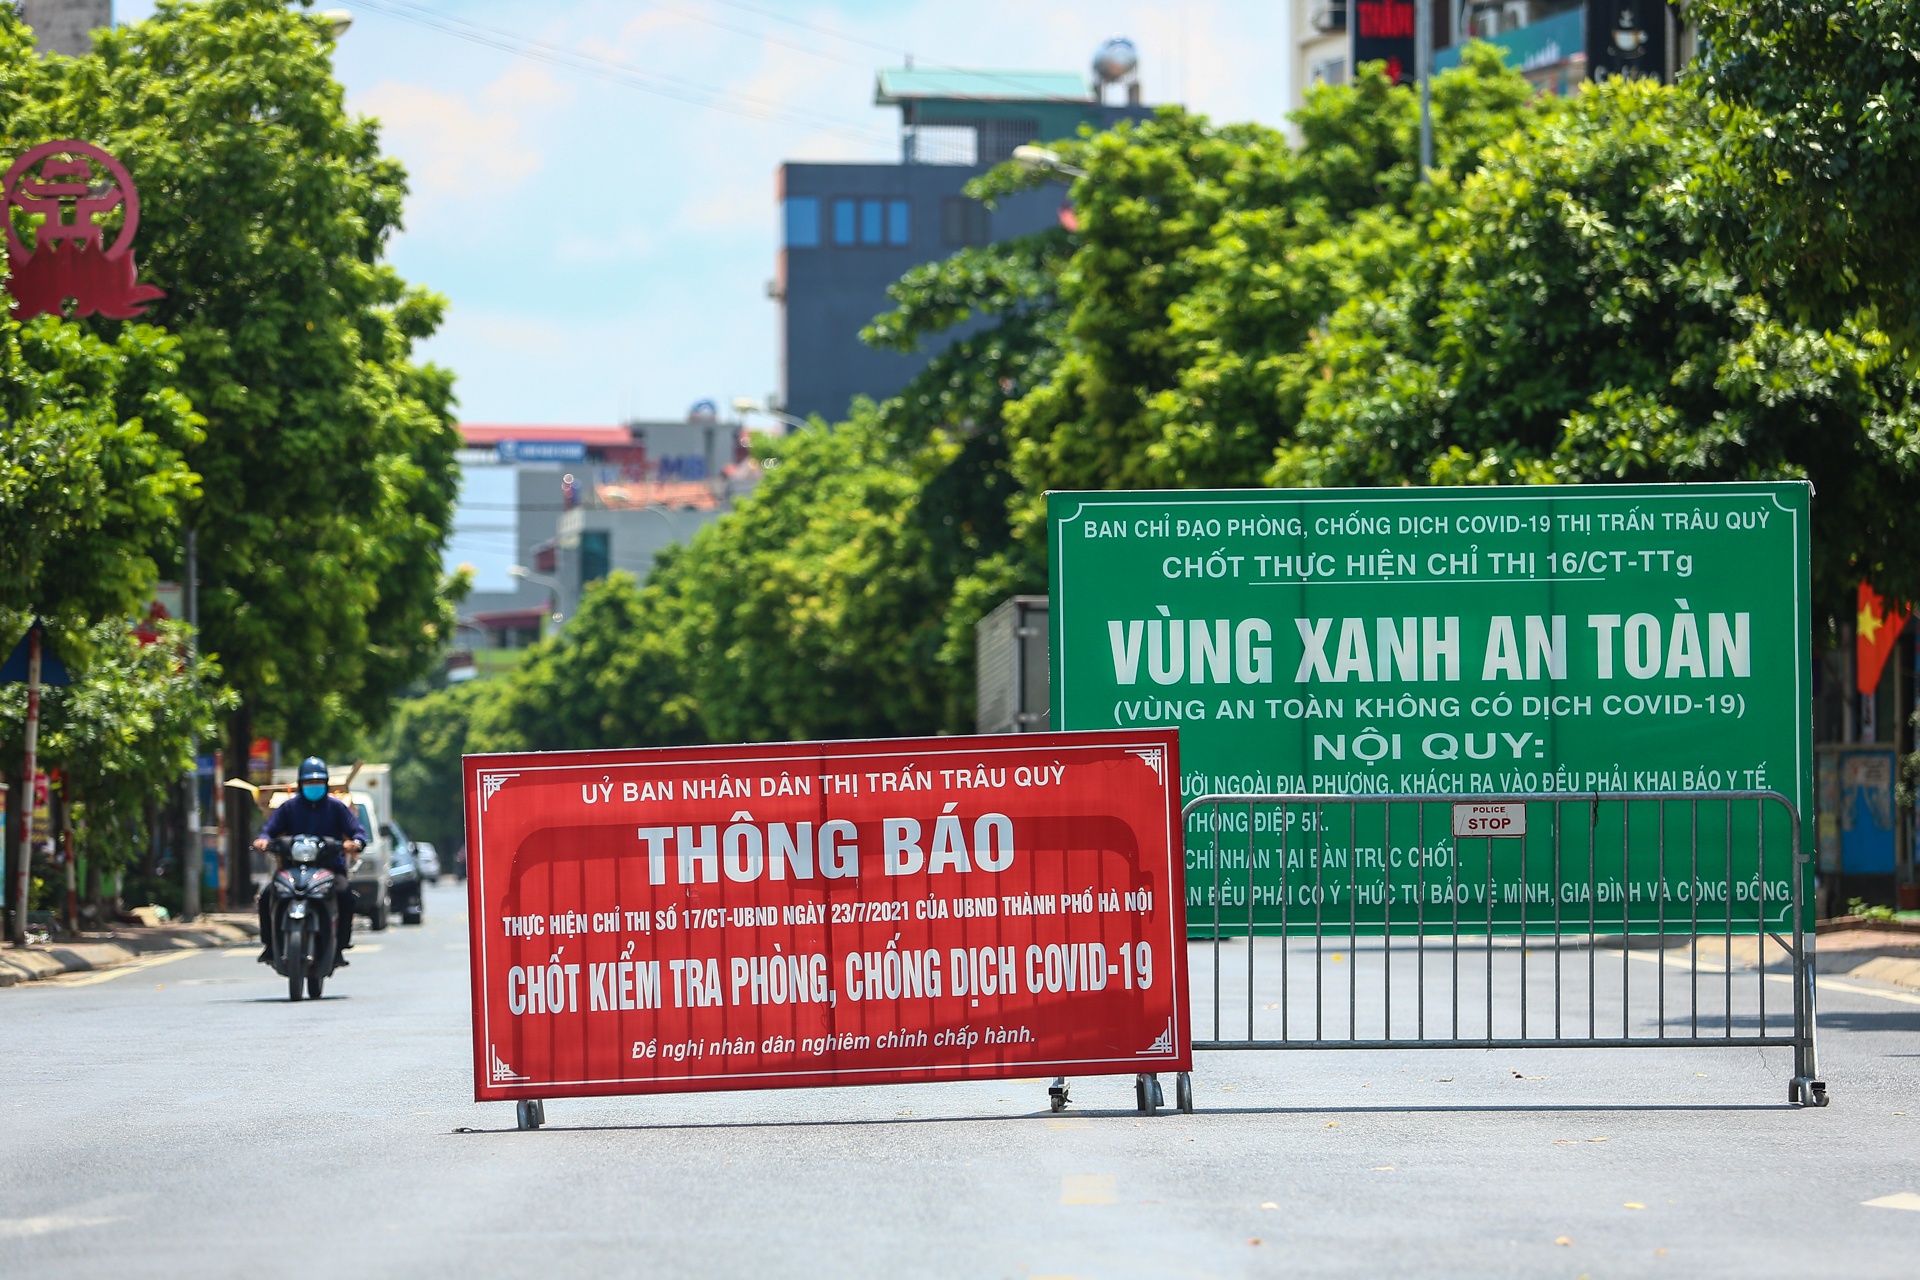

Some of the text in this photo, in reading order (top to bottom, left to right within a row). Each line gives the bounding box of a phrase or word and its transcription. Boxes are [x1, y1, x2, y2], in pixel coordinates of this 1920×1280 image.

[1084, 506, 1770, 540] BAN CHỈ ĐẠO PHÒNG, CHỐNG DỊCH COVID-19 THỊ TRẤN TRÂU QUỲ
[1162, 544, 1694, 581] CHỐT THỰC HIỆN CHỈ THỊ 16/CT-TTg
[1107, 598, 1751, 685] VÙNG XANH AN TOÀN
[1113, 691, 1746, 725] (VÙNG AN TOÀN KHÔNG CÓ DỊCH COVID-19)
[1314, 726, 1544, 766] NỘI QUY:
[582, 760, 1066, 804] UỶ BAN NHÂN DÂN THỊ TRẤN TRÂU QUỲ
[1215, 770, 1270, 794] NGOÀI
[1401, 768, 1463, 793] KHÁCH
[1470, 773, 1494, 792] RA
[1500, 767, 1537, 792] VÀO
[1542, 763, 1580, 792] ĐỀU
[1586, 763, 1627, 791] PHẢI
[1634, 771, 1676, 790] KHAI
[1683, 765, 1721, 790] BÁO
[1726, 770, 1737, 789] Y
[1743, 761, 1771, 789] TẾ.
[1187, 806, 1329, 836] THÔNG ĐIỆP 5K.
[1468, 818, 1511, 830] STOP
[638, 802, 1015, 885] THÔNG BÁO
[1186, 841, 1214, 870] CHỈ
[1276, 849, 1303, 873] TẠI
[1310, 843, 1346, 868] BÀN
[1408, 838, 1463, 867] CHỐT.
[1208, 877, 1245, 906] ĐỀU
[1253, 878, 1292, 906] PHẢI
[1330, 880, 1340, 904] Ý
[1346, 879, 1396, 905] HỨC
[1431, 876, 1469, 904] BẢO
[1504, 878, 1555, 907] MÌNH,
[1560, 883, 1590, 903] GIA
[1597, 877, 1640, 902] ĐÌNH
[1647, 878, 1671, 902] VÀ
[1736, 872, 1793, 901] ĐỒNG.
[503, 886, 1153, 940] THỰC HIỆN CHỈ THỊ SỐ 17/CT-UBND NGÀY 23/7/2021 CỦA UBND THÀNH PHỐ HÀ NỘI
[508, 933, 1153, 1016] CHỐT KIỂM TRA PHÒNG, CHỐNG DỊCH COVID-19
[632, 1024, 1036, 1062] Đề nghị nhân dân nghiêm chỉnh chấp hành.
